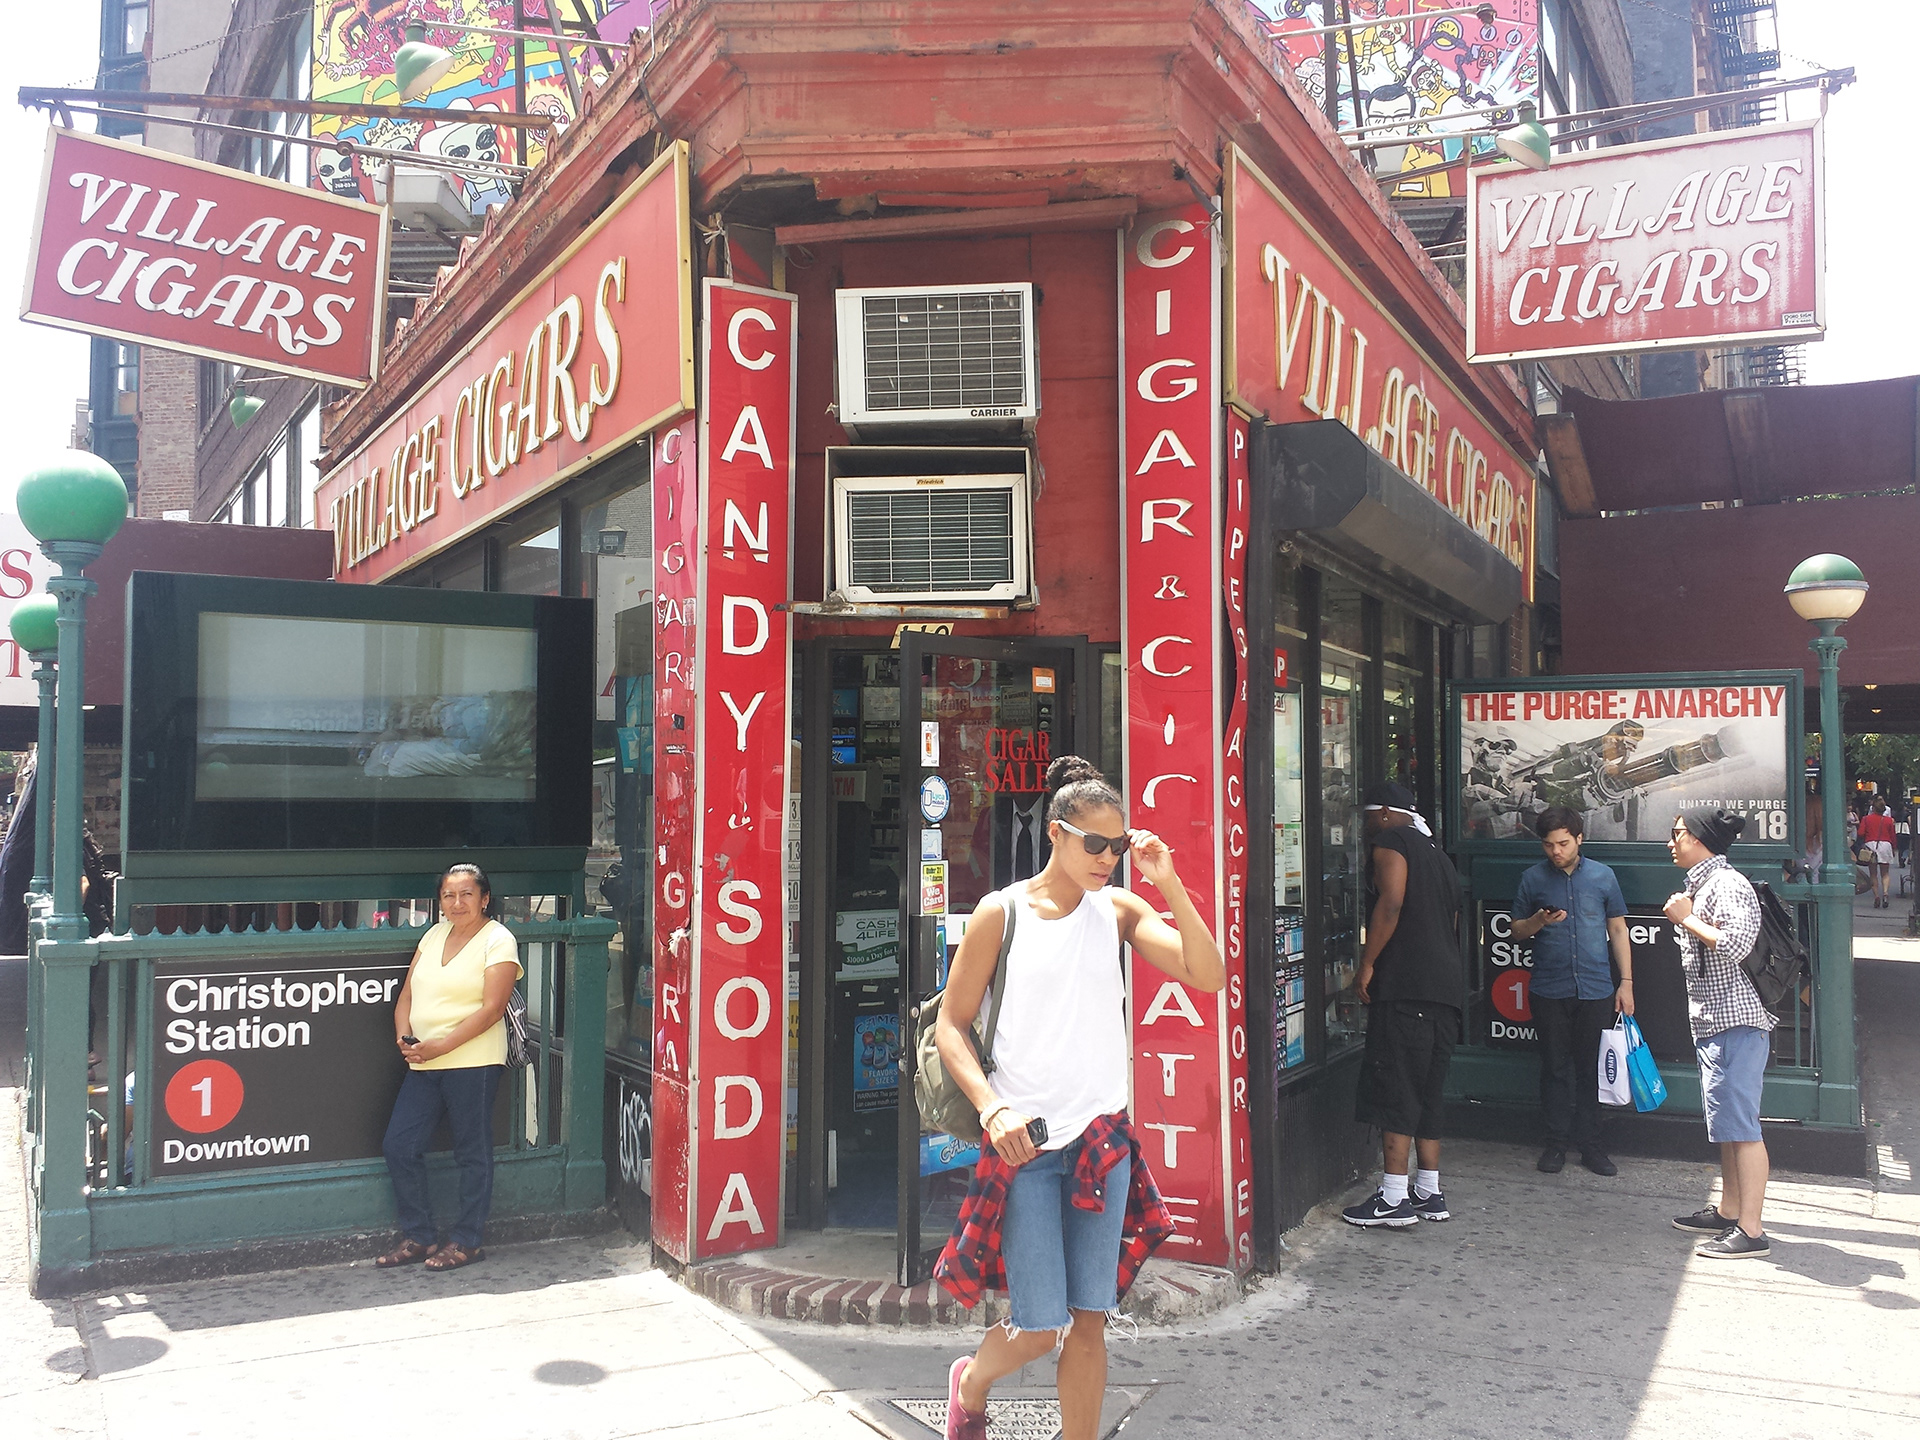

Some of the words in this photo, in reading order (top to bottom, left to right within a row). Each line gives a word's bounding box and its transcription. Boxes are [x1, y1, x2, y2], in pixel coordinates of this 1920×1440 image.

[1490, 159, 1801, 253] VILLAGE
[69, 172, 365, 283] VILLAGE
[56, 238, 354, 354] CIGARS
[1508, 242, 1778, 326] CIGARS
[330, 413, 443, 576] VILLAGE
[451, 255, 625, 500] CIGARS
[970, 409, 1017, 417] CARRIER
[1261, 242, 1439, 495] VILLAGE
[1444, 424, 1528, 573] CIGARS
[720, 307, 777, 753] CANDY
[1464, 693, 1516, 722] THE
[1524, 690, 1627, 721] PURGE:
[1632, 687, 1785, 719] ANARCHY
[985, 728, 1050, 761] CIGAR
[832, 776, 855, 796] TM
[985, 761, 1051, 793] SALE
[1679, 800, 1721, 810] UNITED
[1725, 800, 1744, 810] WE
[1749, 800, 1787, 810] PURGE
[1753, 810, 1787, 840] 18
[923, 894, 944, 907] Card
[926, 887, 940, 897] We
[856, 920, 897, 930] CASH
[856, 930, 896, 940] 4LIFE
[847, 955, 865, 964] $1000
[871, 951, 884, 961] Day
[884, 948, 893, 956] for
[166, 973, 398, 1013] Christopher
[1508, 981, 1523, 1010] 1
[165, 1016, 310, 1054] Station
[705, 879, 771, 1240] SODA
[868, 1069, 898, 1077] FLAVORS
[190, 1076, 213, 1118] 1
[876, 1077, 895, 1085] SIZES
[163, 1131, 310, 1164] Downtown
